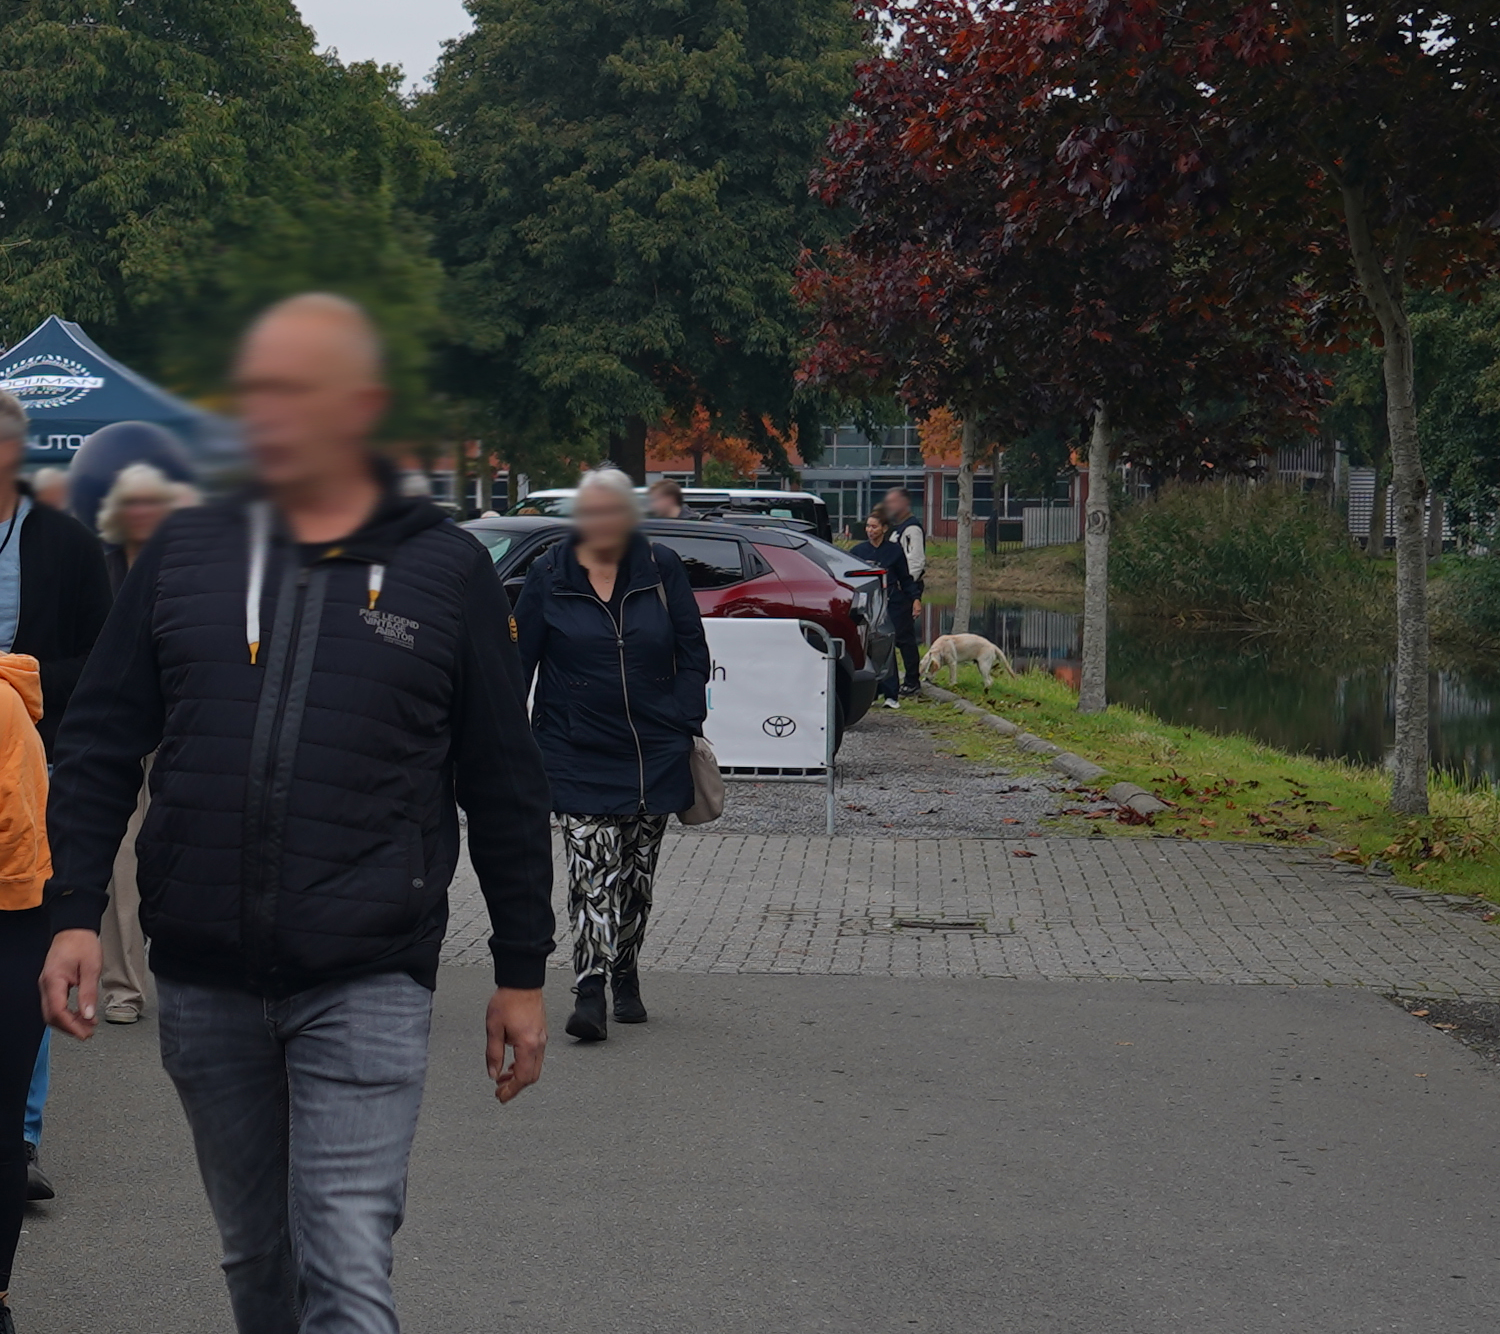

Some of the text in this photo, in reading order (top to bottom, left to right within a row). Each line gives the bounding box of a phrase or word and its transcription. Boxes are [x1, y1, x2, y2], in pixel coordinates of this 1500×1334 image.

[363, 616, 406, 633] VINTAGE
[382, 613, 420, 629] LEGEND
[375, 627, 415, 643] AVIATOR
